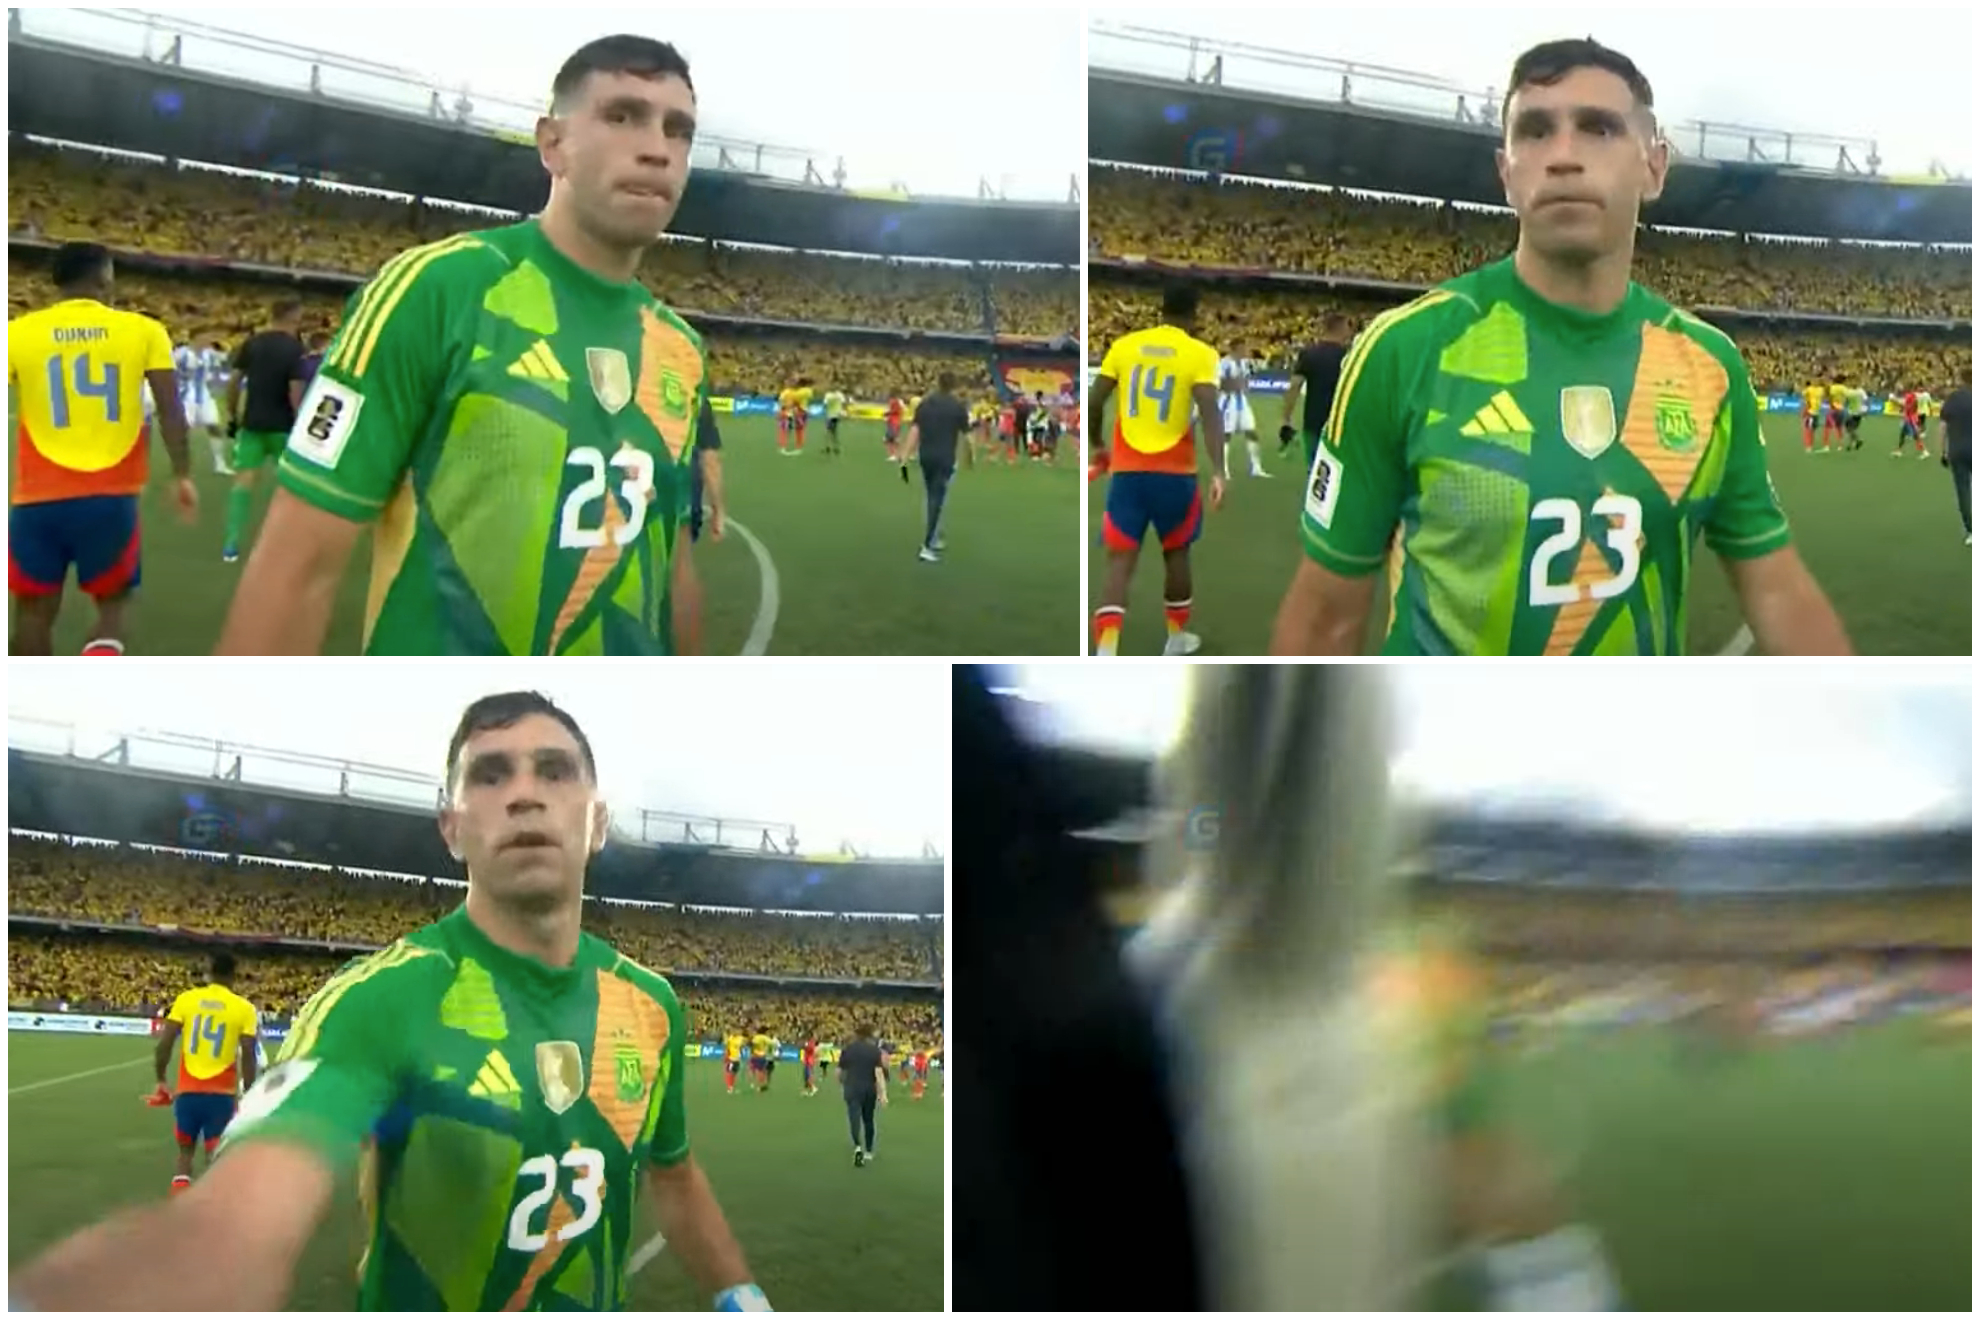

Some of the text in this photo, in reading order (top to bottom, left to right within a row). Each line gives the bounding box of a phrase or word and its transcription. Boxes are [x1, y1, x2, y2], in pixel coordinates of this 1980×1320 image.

[47, 353, 121, 429] 14
[1127, 363, 1175, 423] 14
[559, 446, 654, 549] 23
[1529, 494, 1642, 607] 23
[190, 1013, 226, 1058] 14
[507, 1147, 605, 1252] 23
